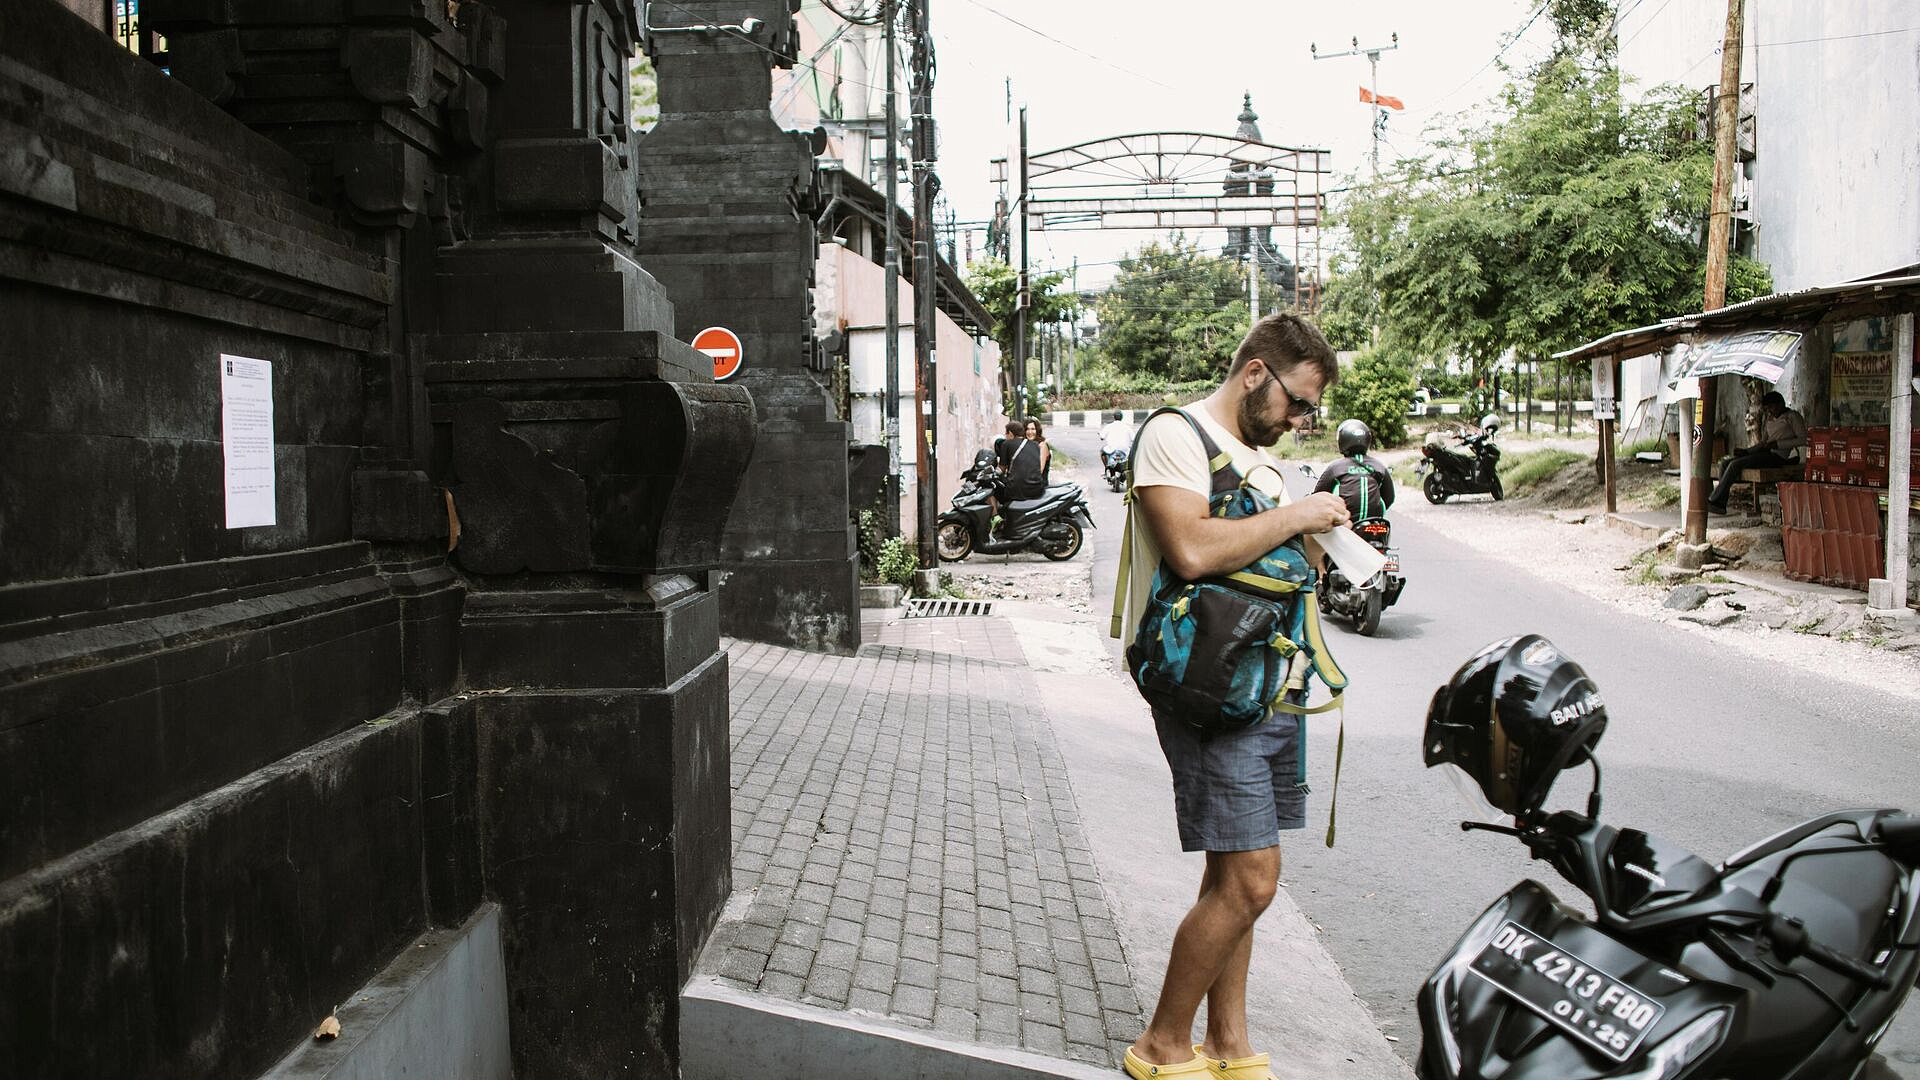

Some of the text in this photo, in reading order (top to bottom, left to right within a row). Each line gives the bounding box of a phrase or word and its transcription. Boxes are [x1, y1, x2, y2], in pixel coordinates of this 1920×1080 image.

[713, 356, 727, 366] UT
[1861, 354, 1878, 374] FOR
[1491, 925, 1536, 960] DK
[1532, 951, 1602, 998] 4213
